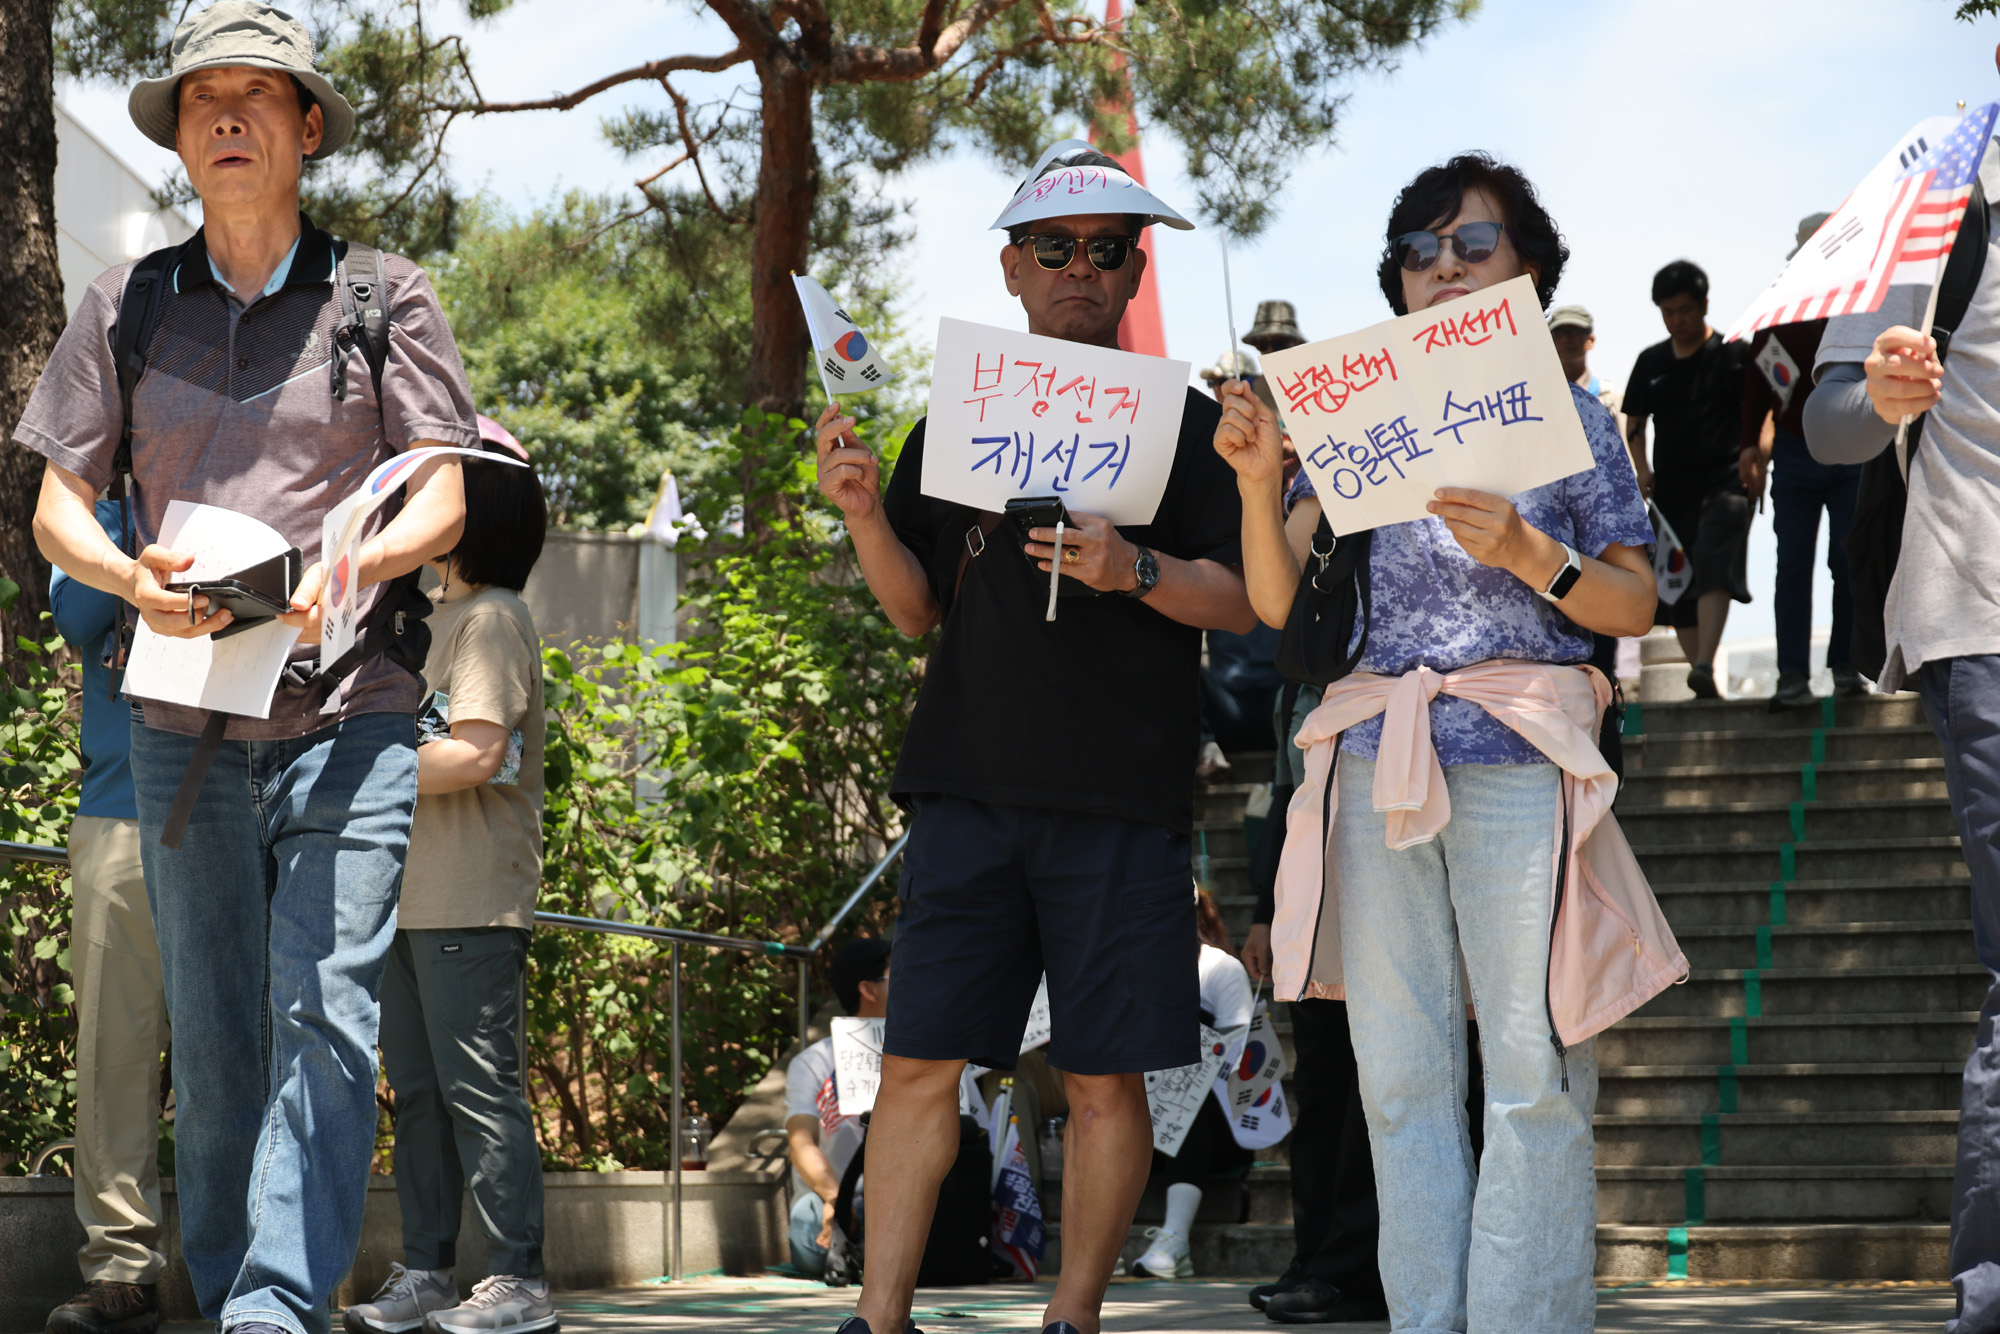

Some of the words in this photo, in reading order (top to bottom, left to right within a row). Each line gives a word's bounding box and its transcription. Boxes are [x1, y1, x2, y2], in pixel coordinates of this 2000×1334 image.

[364, 308, 382, 318] K2
[963, 353, 1140, 423] 부정선거
[1277, 347, 1398, 415] 부정선거
[1413, 298, 1517, 353] 재선거
[971, 431, 1130, 491] 재선거
[1306, 416, 1433, 499] 당일투표
[1433, 381, 1544, 444] 수개표
